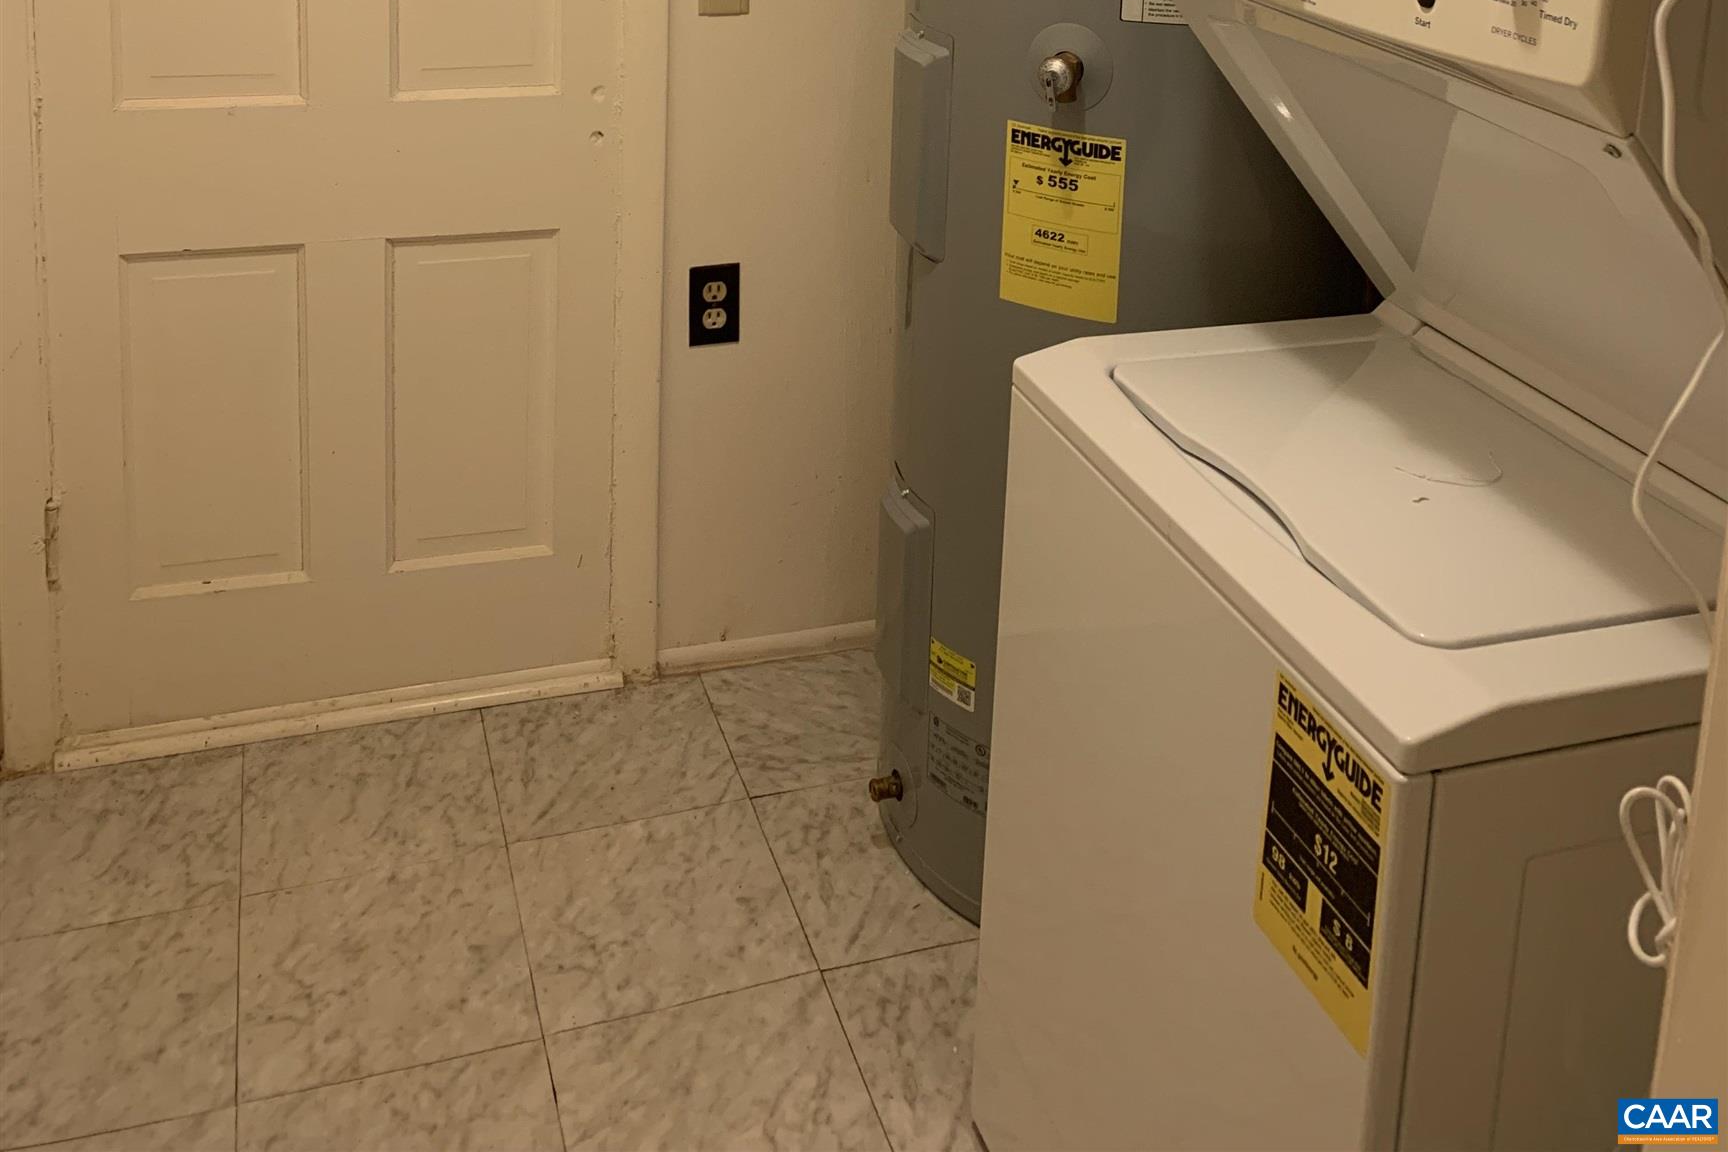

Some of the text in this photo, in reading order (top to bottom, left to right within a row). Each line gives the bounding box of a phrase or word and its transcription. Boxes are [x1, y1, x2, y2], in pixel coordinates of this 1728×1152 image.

[1414, 16, 1431, 29] Start
[1539, 9, 1578, 30] Timed Dry
[1491, 26, 1537, 46] DRYER CYCLES
[1011, 128, 1122, 163] ENERGYGUIDE
[1036, 175, 1079, 192] $ 555
[1034, 228, 1065, 243] 4622
[1278, 681, 1384, 812] ENERGYGUIDE
[1271, 846, 1286, 871] 98
[1314, 834, 1338, 875] $12
[1345, 933, 1353, 952] 8
